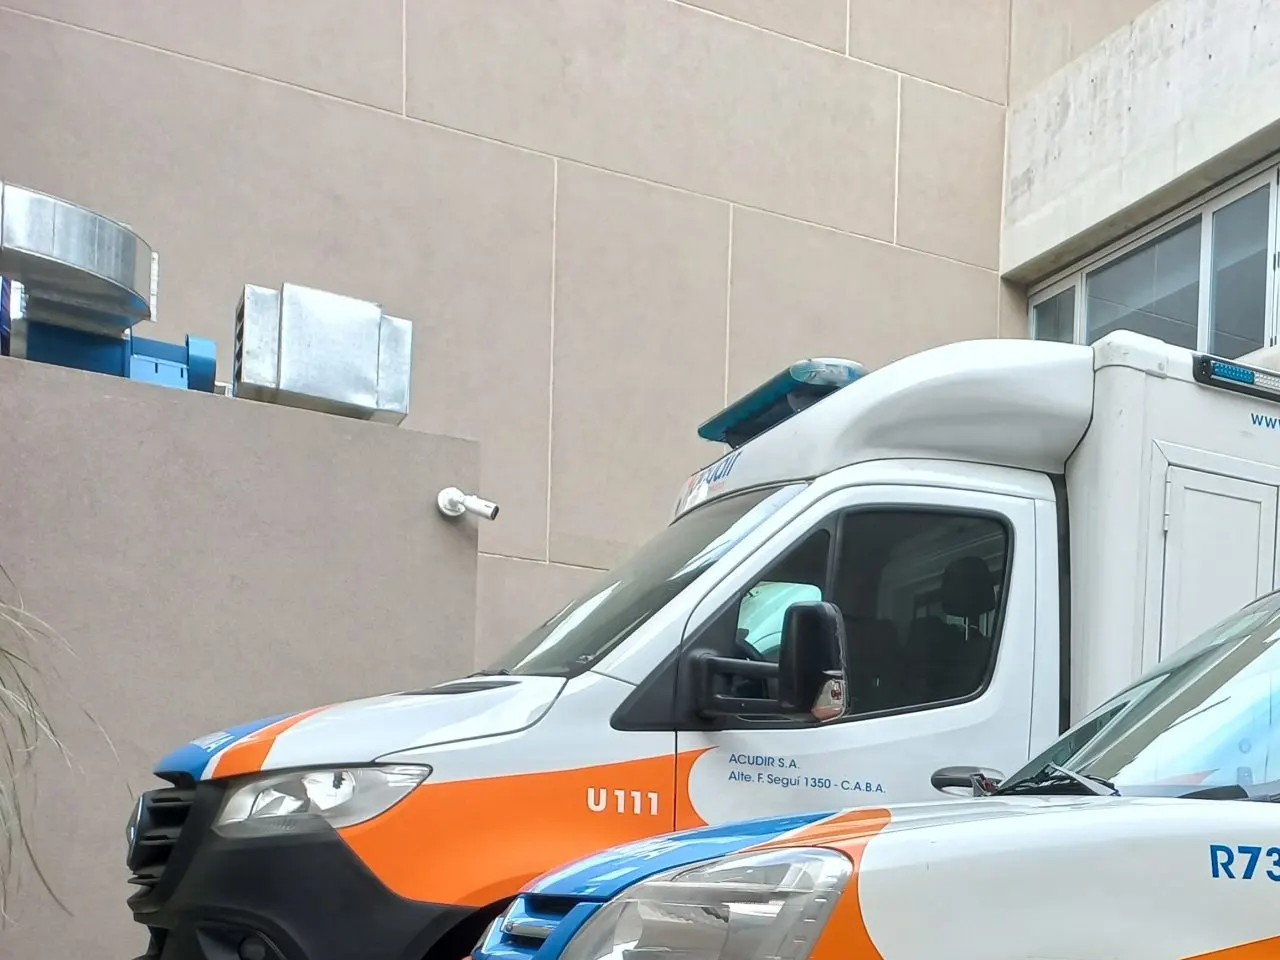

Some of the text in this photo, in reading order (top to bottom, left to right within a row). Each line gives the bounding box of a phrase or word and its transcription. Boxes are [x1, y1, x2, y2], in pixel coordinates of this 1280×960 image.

[728, 753, 801, 770] ACUDIR S.A.
[728, 770, 755, 784] Alte.
[756, 772, 766, 784] F.
[767, 773, 802, 789] Seguí
[804, 777, 832, 790] 1350
[841, 780, 887, 794] C.A.B.A.
[587, 786, 660, 816] U111
